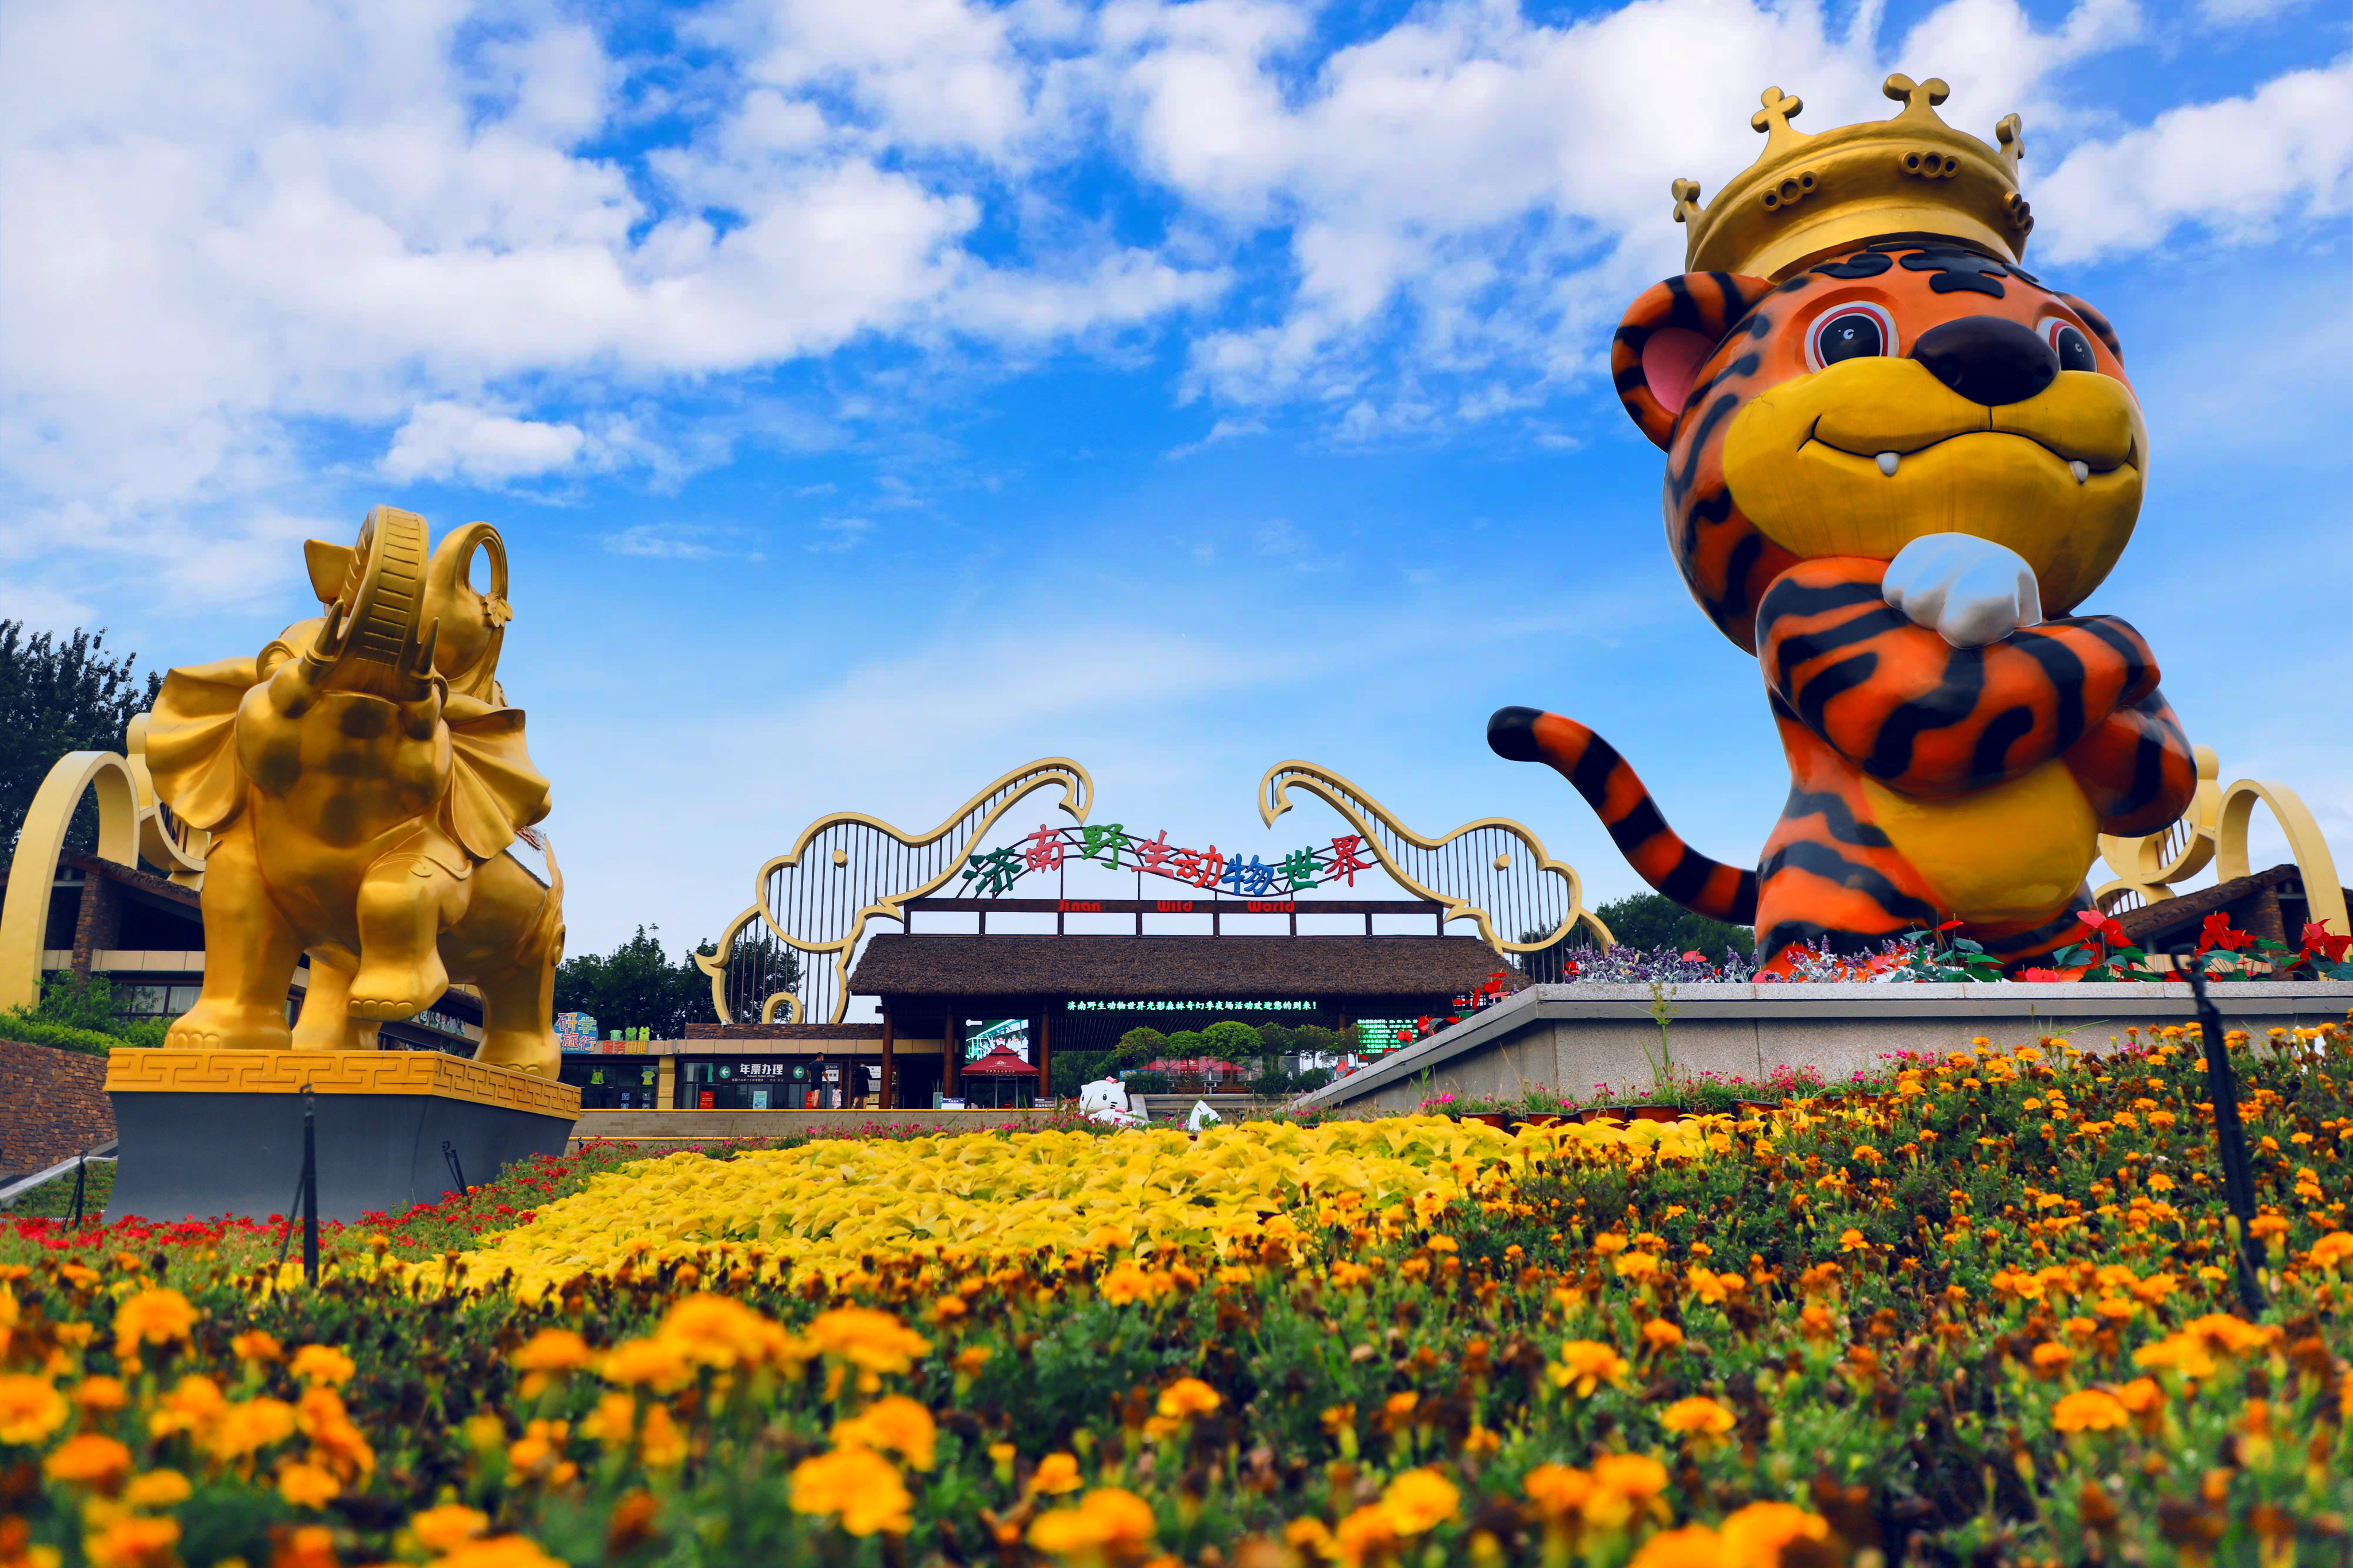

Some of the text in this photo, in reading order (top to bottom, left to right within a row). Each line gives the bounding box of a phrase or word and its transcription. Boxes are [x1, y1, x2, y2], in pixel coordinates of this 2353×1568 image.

[962, 824, 1372, 895] 济南野生动物世界
[1058, 899, 1295, 912] Jinan Wild World
[556, 1013, 597, 1034] 研学
[562, 1029, 596, 1051] 旅行
[603, 1040, 646, 1055] 服务中心
[739, 1063, 784, 1075] 年票办理
